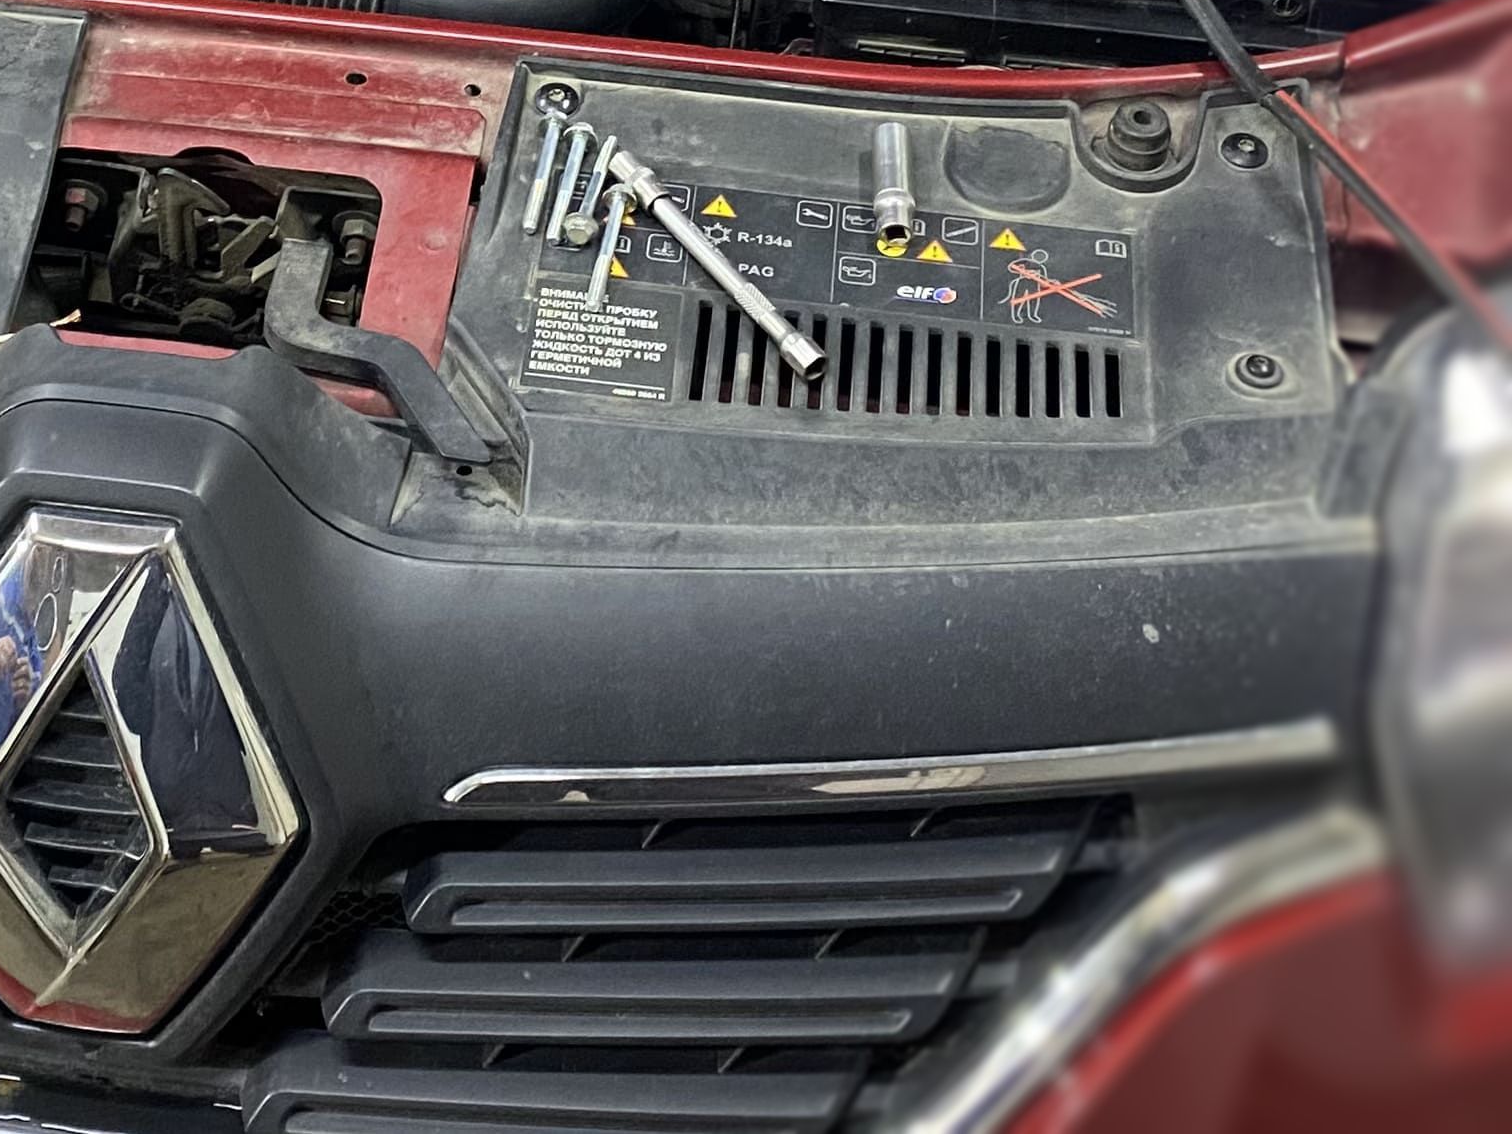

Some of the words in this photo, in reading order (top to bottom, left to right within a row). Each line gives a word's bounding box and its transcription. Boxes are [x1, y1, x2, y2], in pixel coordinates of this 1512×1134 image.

[737, 231, 793, 248] R-134a
[738, 263, 775, 277] PAG
[896, 285, 935, 300] elf
[537, 308, 579, 321] ПЕРЕД
[581, 313, 659, 330] ОТКРЫТИЕМ
[606, 305, 658, 319] ПРОБКУ
[535, 319, 626, 336] ИСПОЛЬЗУЙТЕ
[534, 329, 586, 343] ТОЛЬКО
[588, 335, 667, 352] ТОРМОЗНУЮ
[530, 350, 622, 368] ГЕРМЕТИЧНОЙ
[532, 339, 603, 355] ЖИДКОСТЬ
[605, 347, 632, 359] ДОТ
[643, 352, 662, 363] ИЗ
[528, 360, 590, 376] ЕМКОСТИ
